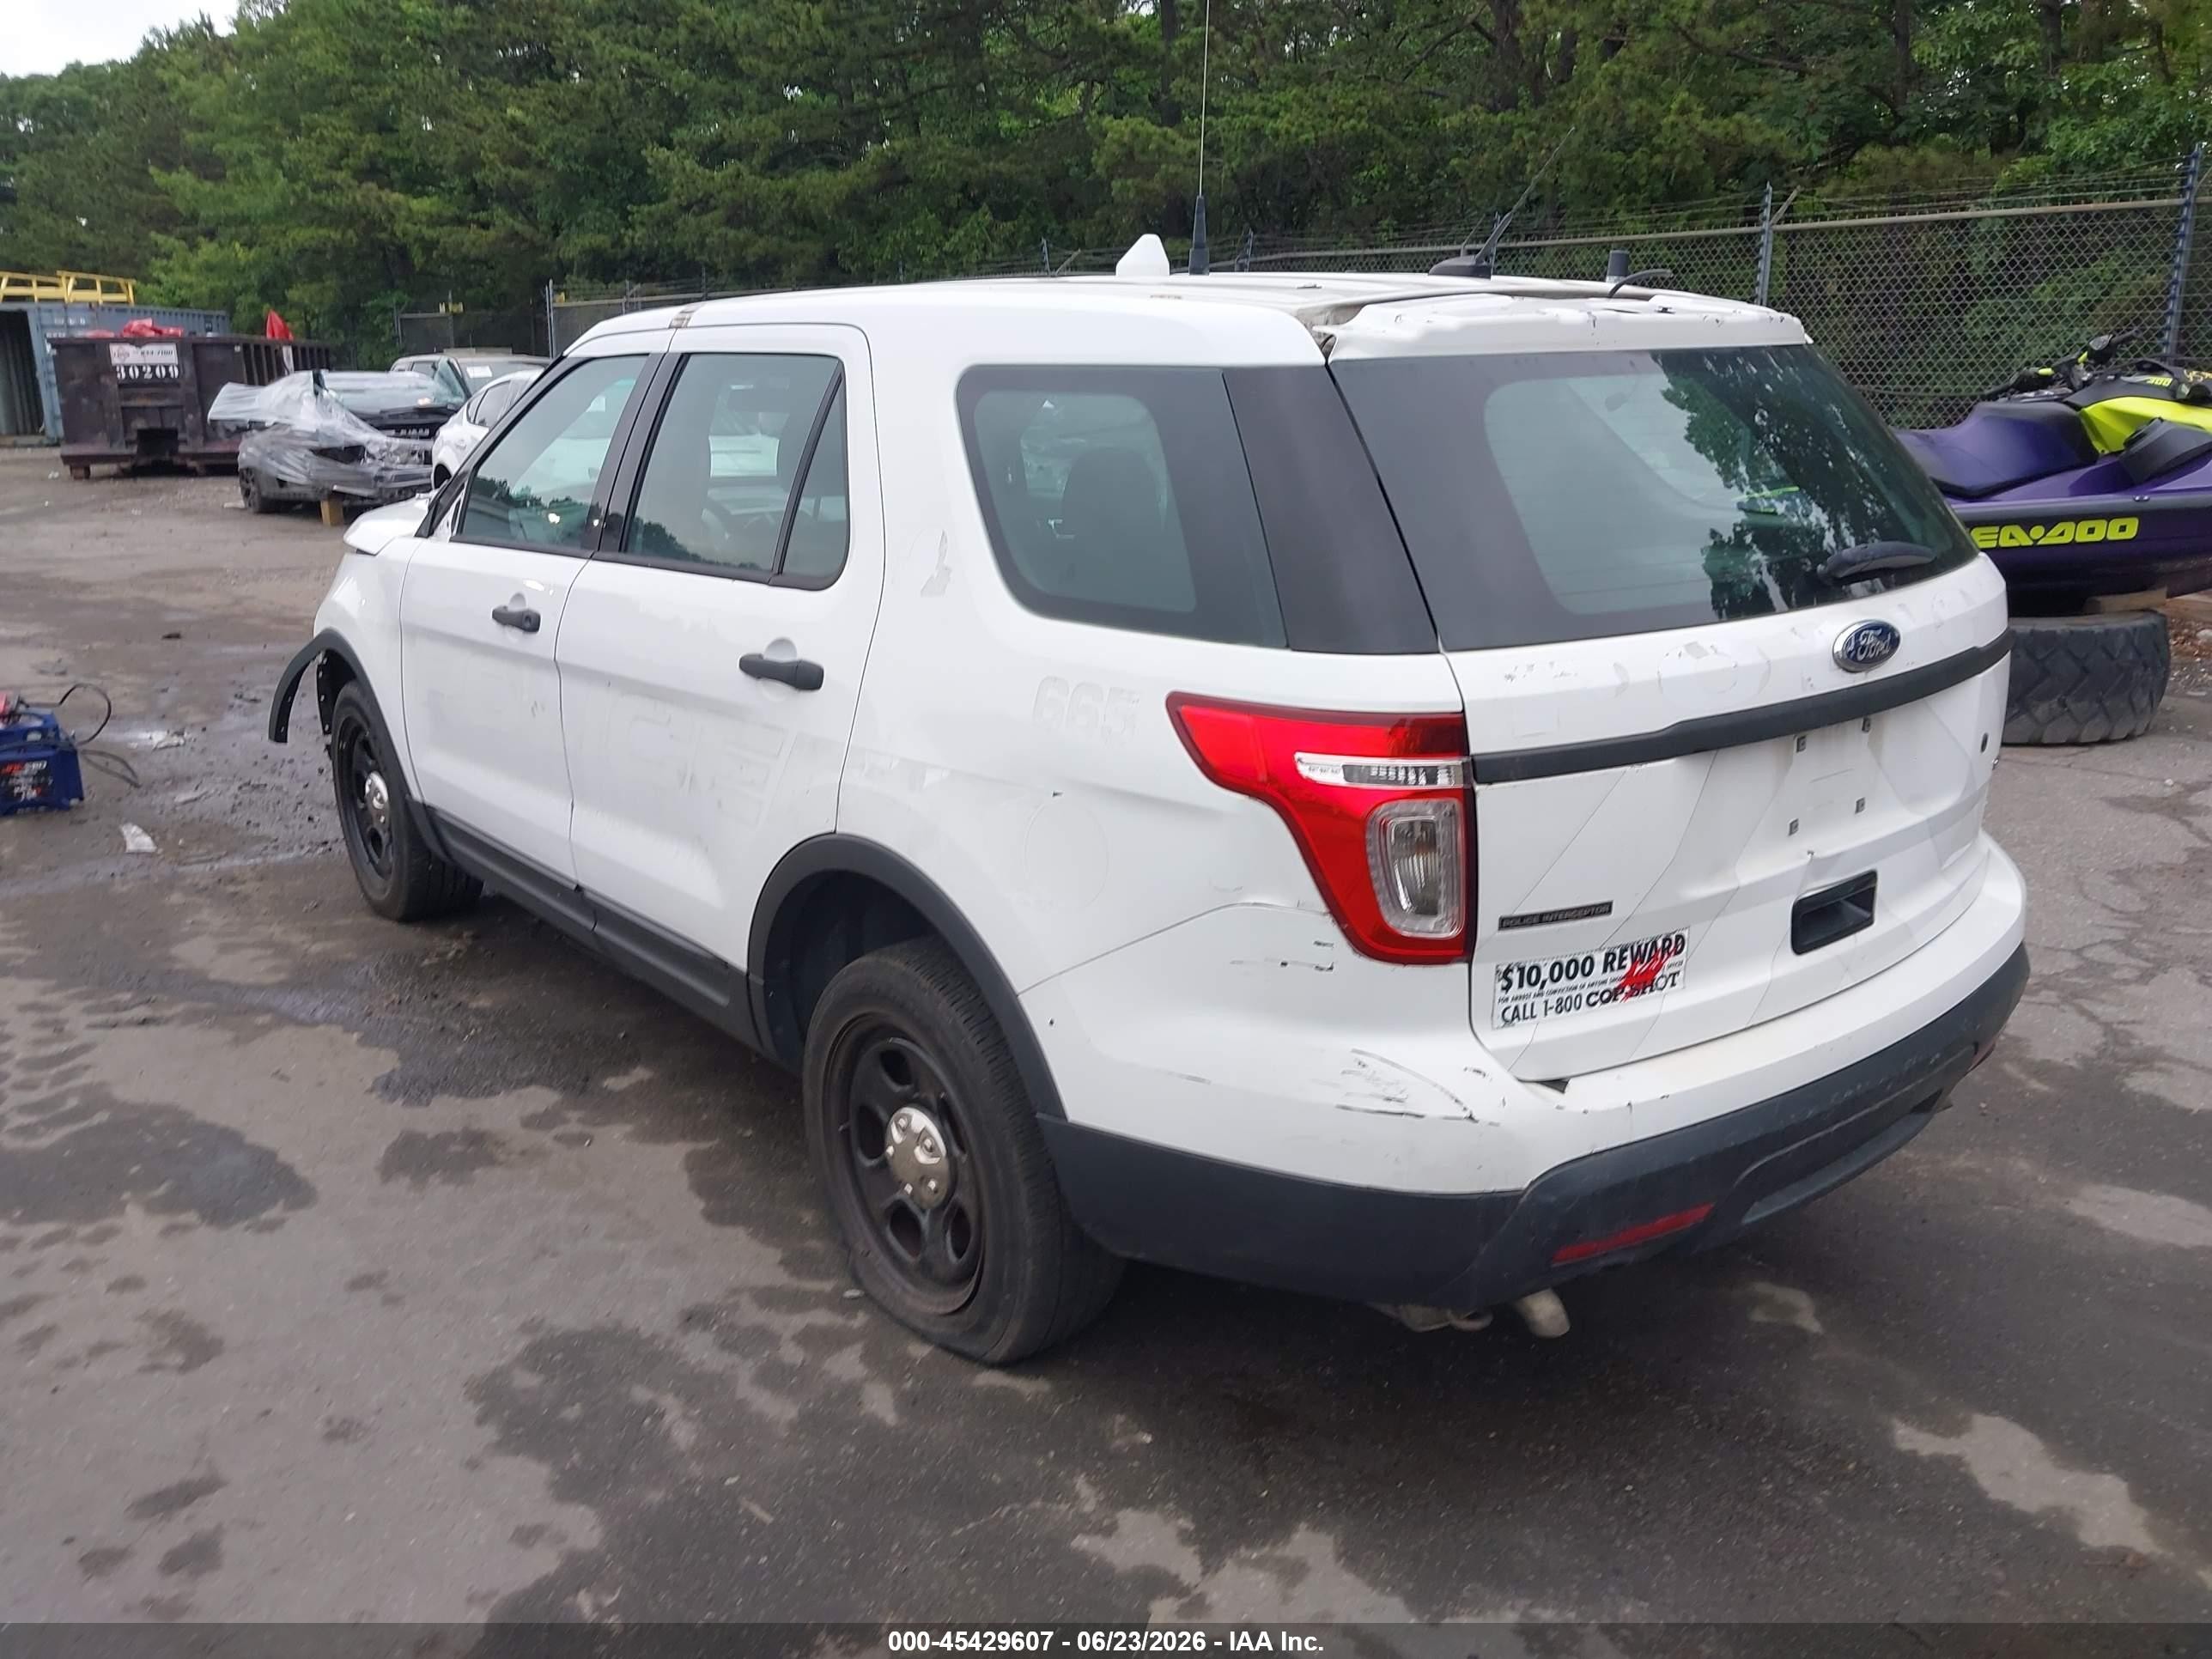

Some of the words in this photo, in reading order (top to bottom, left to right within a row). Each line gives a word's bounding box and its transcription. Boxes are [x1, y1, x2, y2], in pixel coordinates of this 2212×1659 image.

[116, 365, 179, 380] 30209
[1856, 628, 1892, 661] Ford
[1503, 915, 1540, 927] POLICE
[1542, 905, 1610, 921] INTERCEPTOR
[1501, 955, 1595, 994] $10,000
[1602, 934, 1686, 975] REWARD
[1501, 1001, 1537, 1024] CALL
[1543, 993, 1583, 1018] 1-800
